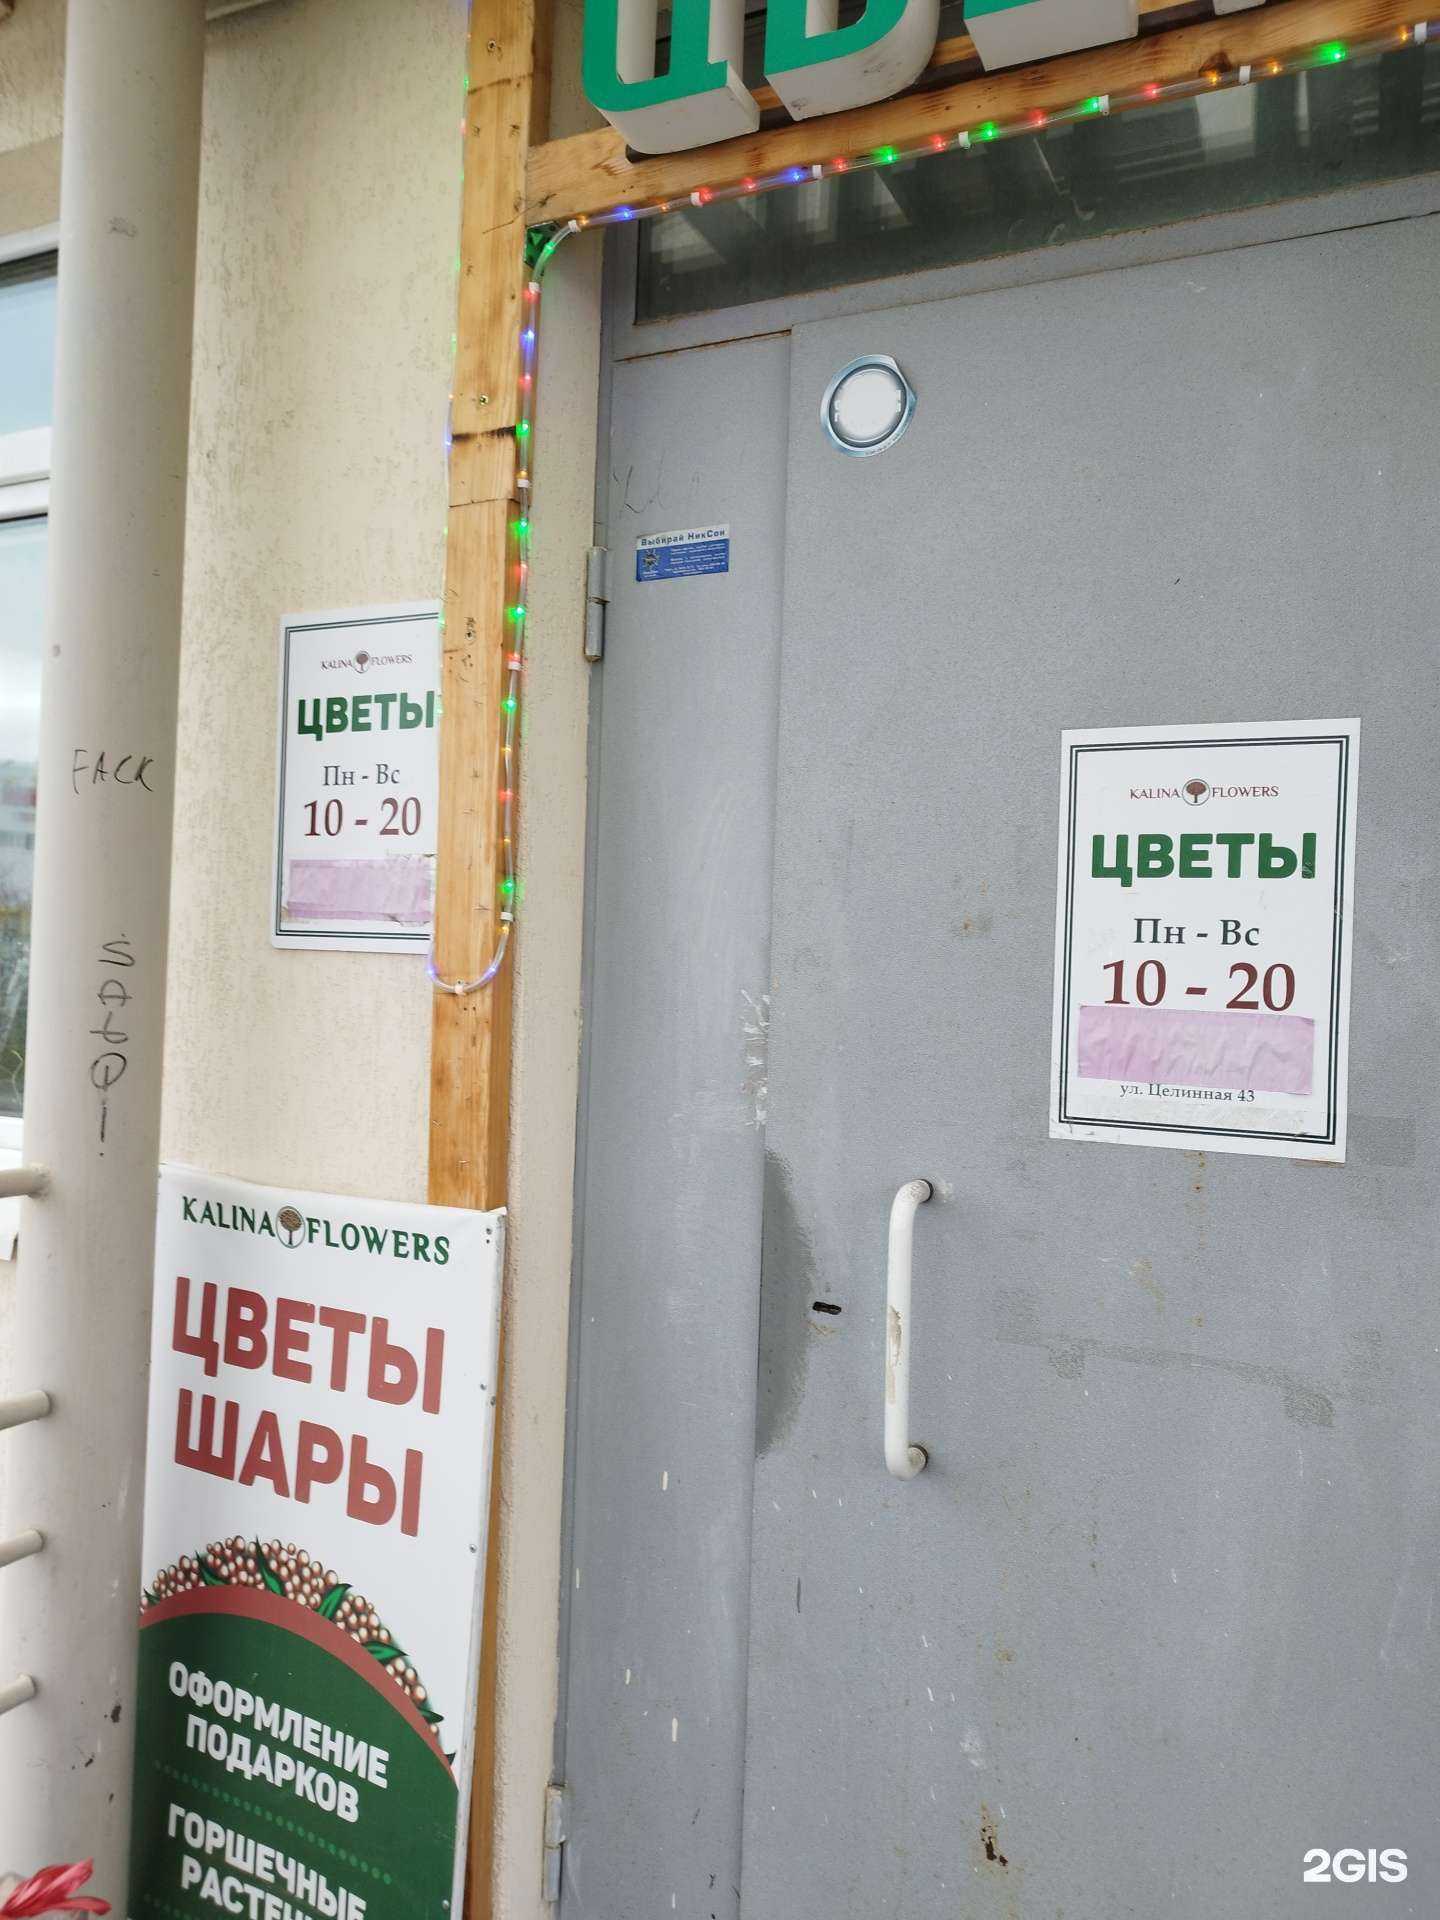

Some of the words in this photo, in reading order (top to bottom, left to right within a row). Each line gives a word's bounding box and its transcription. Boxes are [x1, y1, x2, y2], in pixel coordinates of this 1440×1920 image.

[298, 690, 435, 742] ЦВЕТЫ
[323, 766, 355, 786] Пн
[375, 764, 401, 785] Вс
[1130, 787, 1181, 800] KALINA
[1212, 785, 1280, 799] FLOWERS
[303, 798, 344, 837] 10
[379, 796, 422, 836] 20
[1091, 832, 1318, 888] ЦВЕТЫ
[1133, 918, 1186, 946] Пн
[1220, 919, 1260, 946] Вс
[1102, 959, 1167, 1007] 10
[1226, 962, 1296, 1012] 20
[1120, 1083, 1143, 1097] ул.
[1148, 1083, 1233, 1102] Целинная
[1237, 1089, 1256, 1103] 43
[182, 1196, 276, 1239] KALINA
[307, 1217, 451, 1266] FLOWERS
[172, 1276, 446, 1415] ЦВЕТЫ
[174, 1387, 424, 1538] ШАРЫ
[168, 1661, 390, 1790] ОФОРМЛЕНИЕ
[185, 1713, 360, 1824] ПОДАРКОВ
